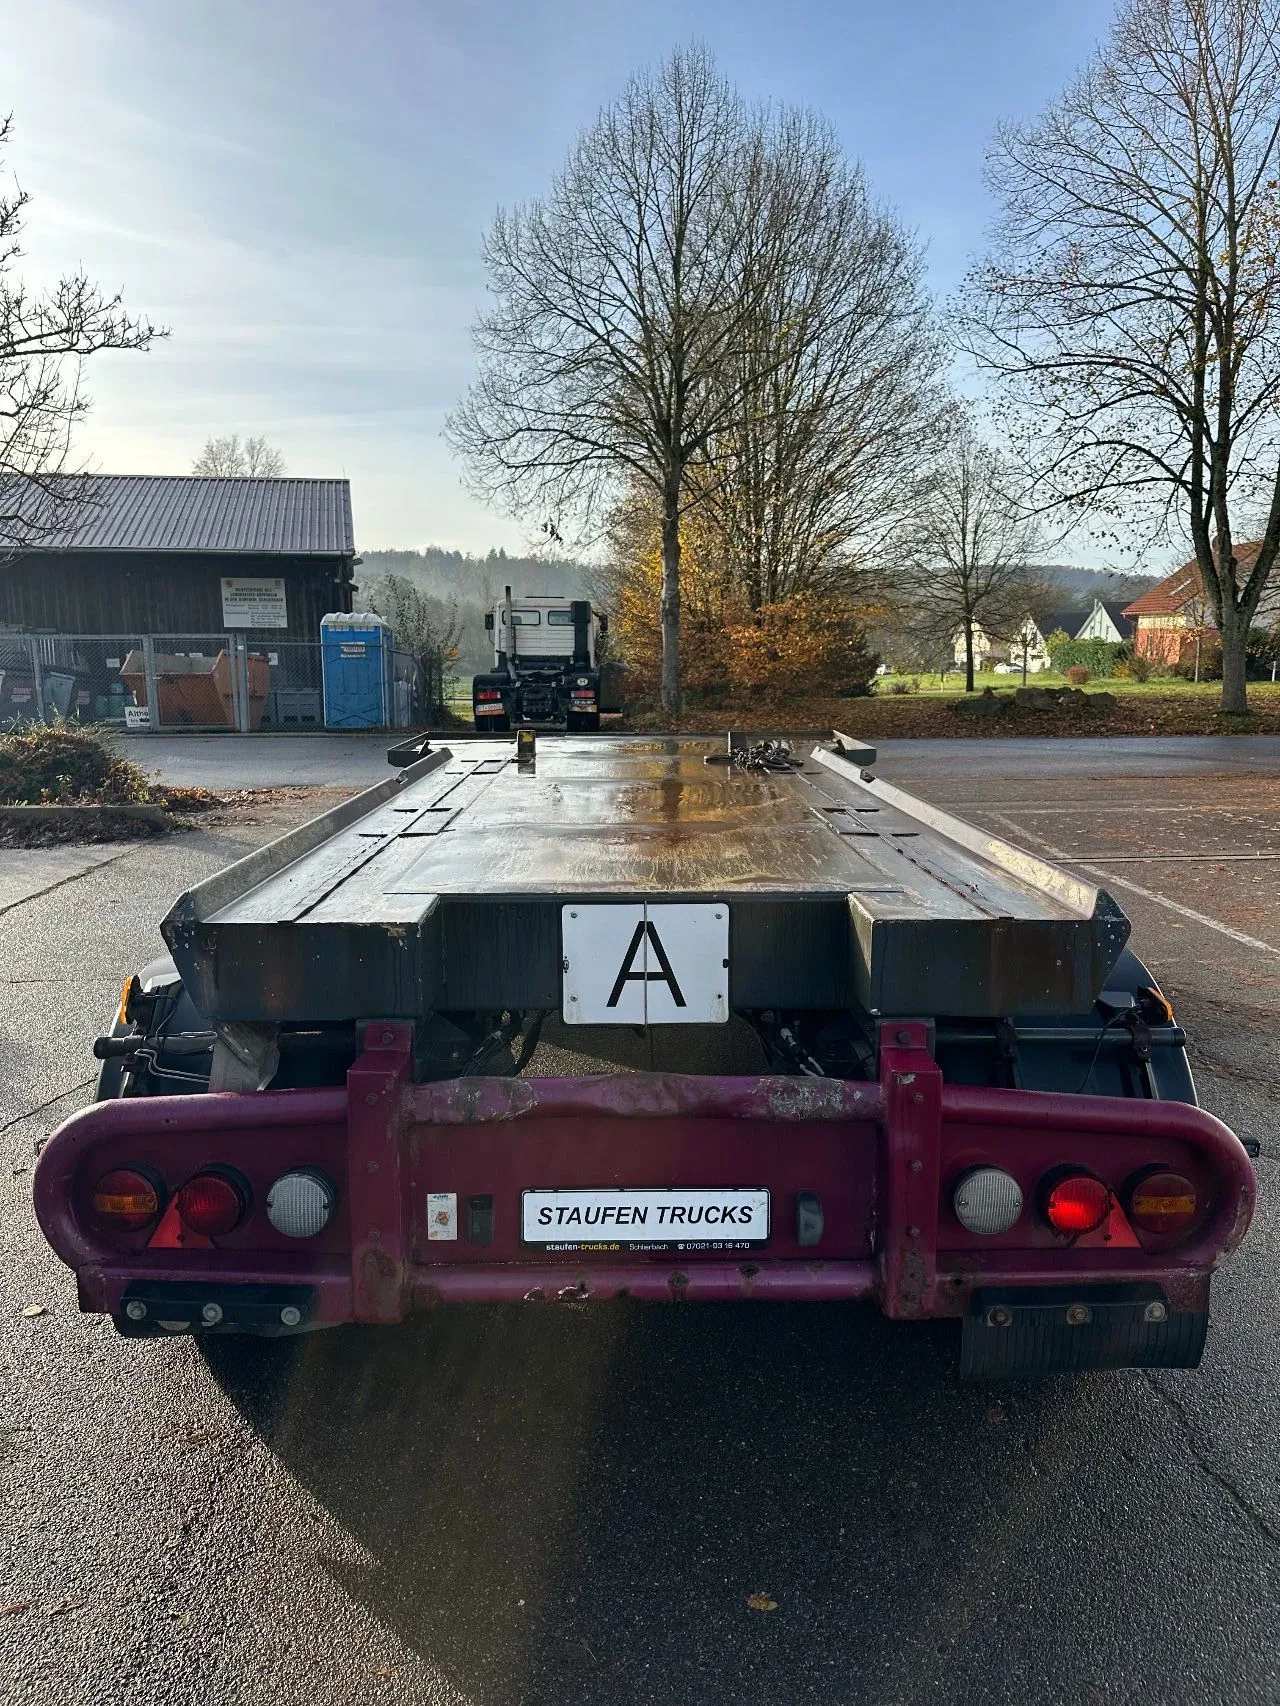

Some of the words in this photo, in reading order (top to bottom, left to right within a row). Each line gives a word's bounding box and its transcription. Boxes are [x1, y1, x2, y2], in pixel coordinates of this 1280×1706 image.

[606, 921, 687, 1007] A
[538, 1206, 649, 1225] STAUFEN
[657, 1205, 754, 1224] TRUCKS
[545, 1242, 620, 1251] staufen-trucks.de
